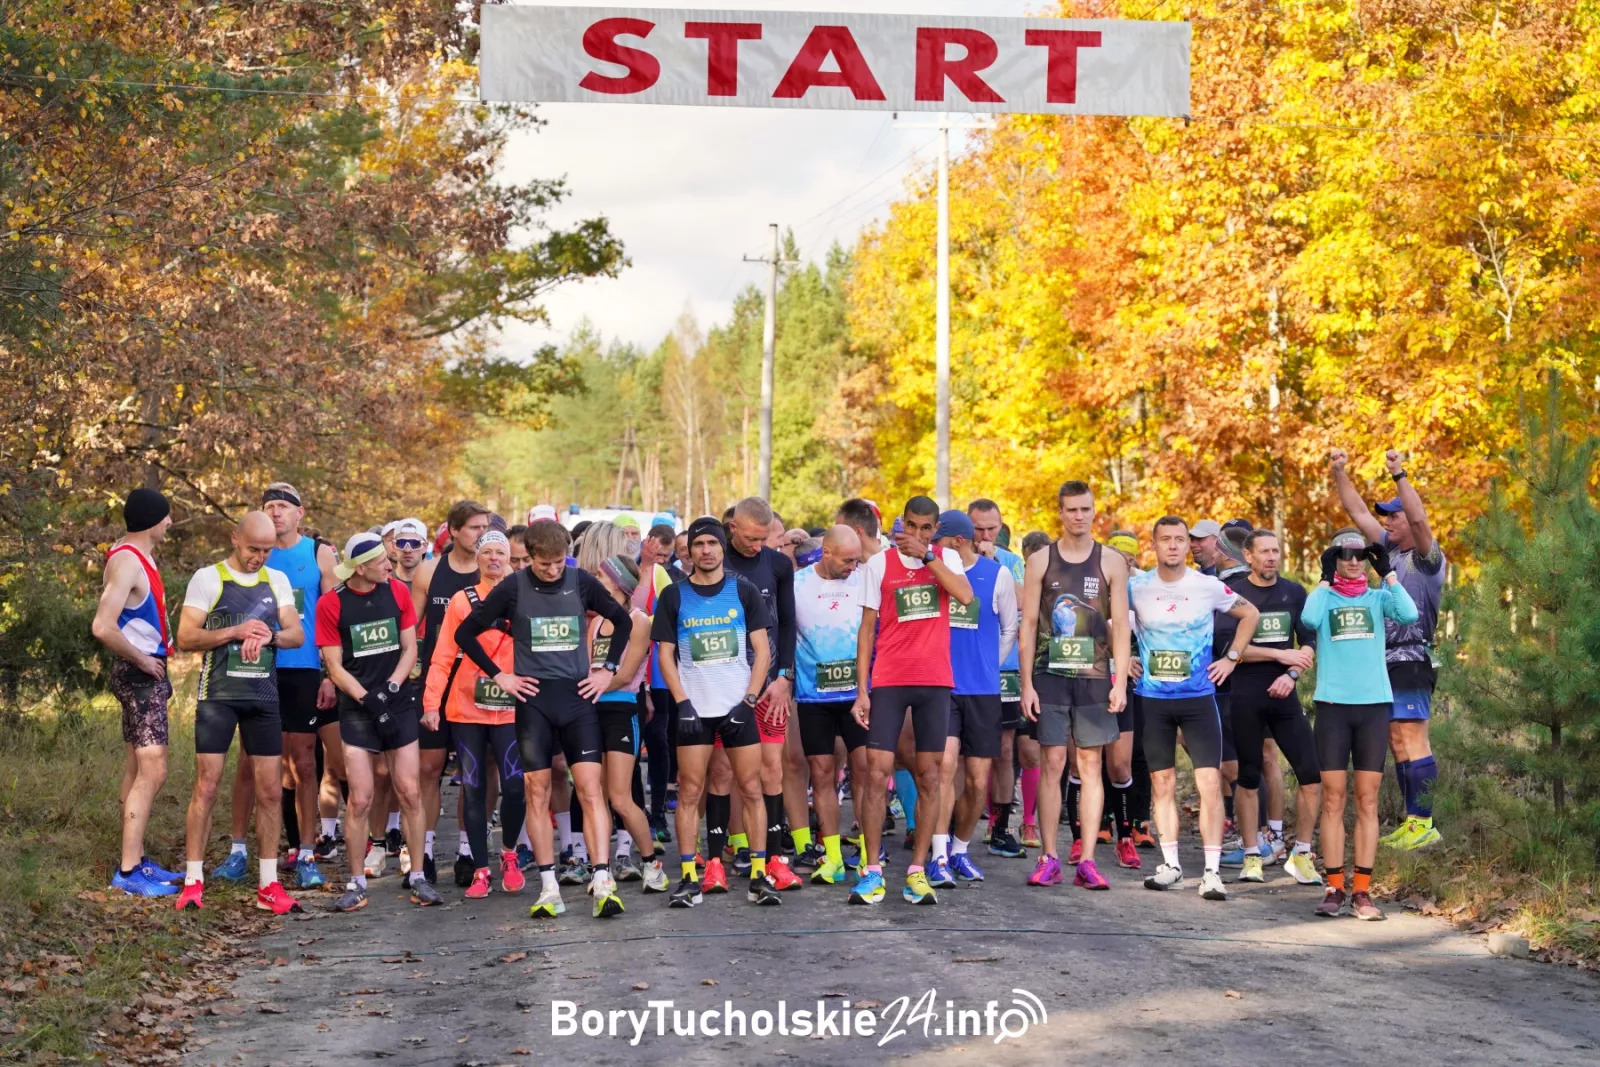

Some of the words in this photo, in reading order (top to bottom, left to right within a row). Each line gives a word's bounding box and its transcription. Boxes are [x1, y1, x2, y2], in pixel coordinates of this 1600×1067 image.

[579, 17, 1102, 104] START
[903, 591, 931, 607] 169
[683, 615, 731, 628] Ukraine
[1262, 618, 1281, 630] 88
[1337, 612, 1365, 627] 152
[360, 627, 388, 642] 140
[540, 624, 569, 637] 150
[701, 636, 727, 651] 151
[1062, 643, 1081, 656] 92
[1156, 656, 1181, 669] 120
[825, 666, 852, 680] 109
